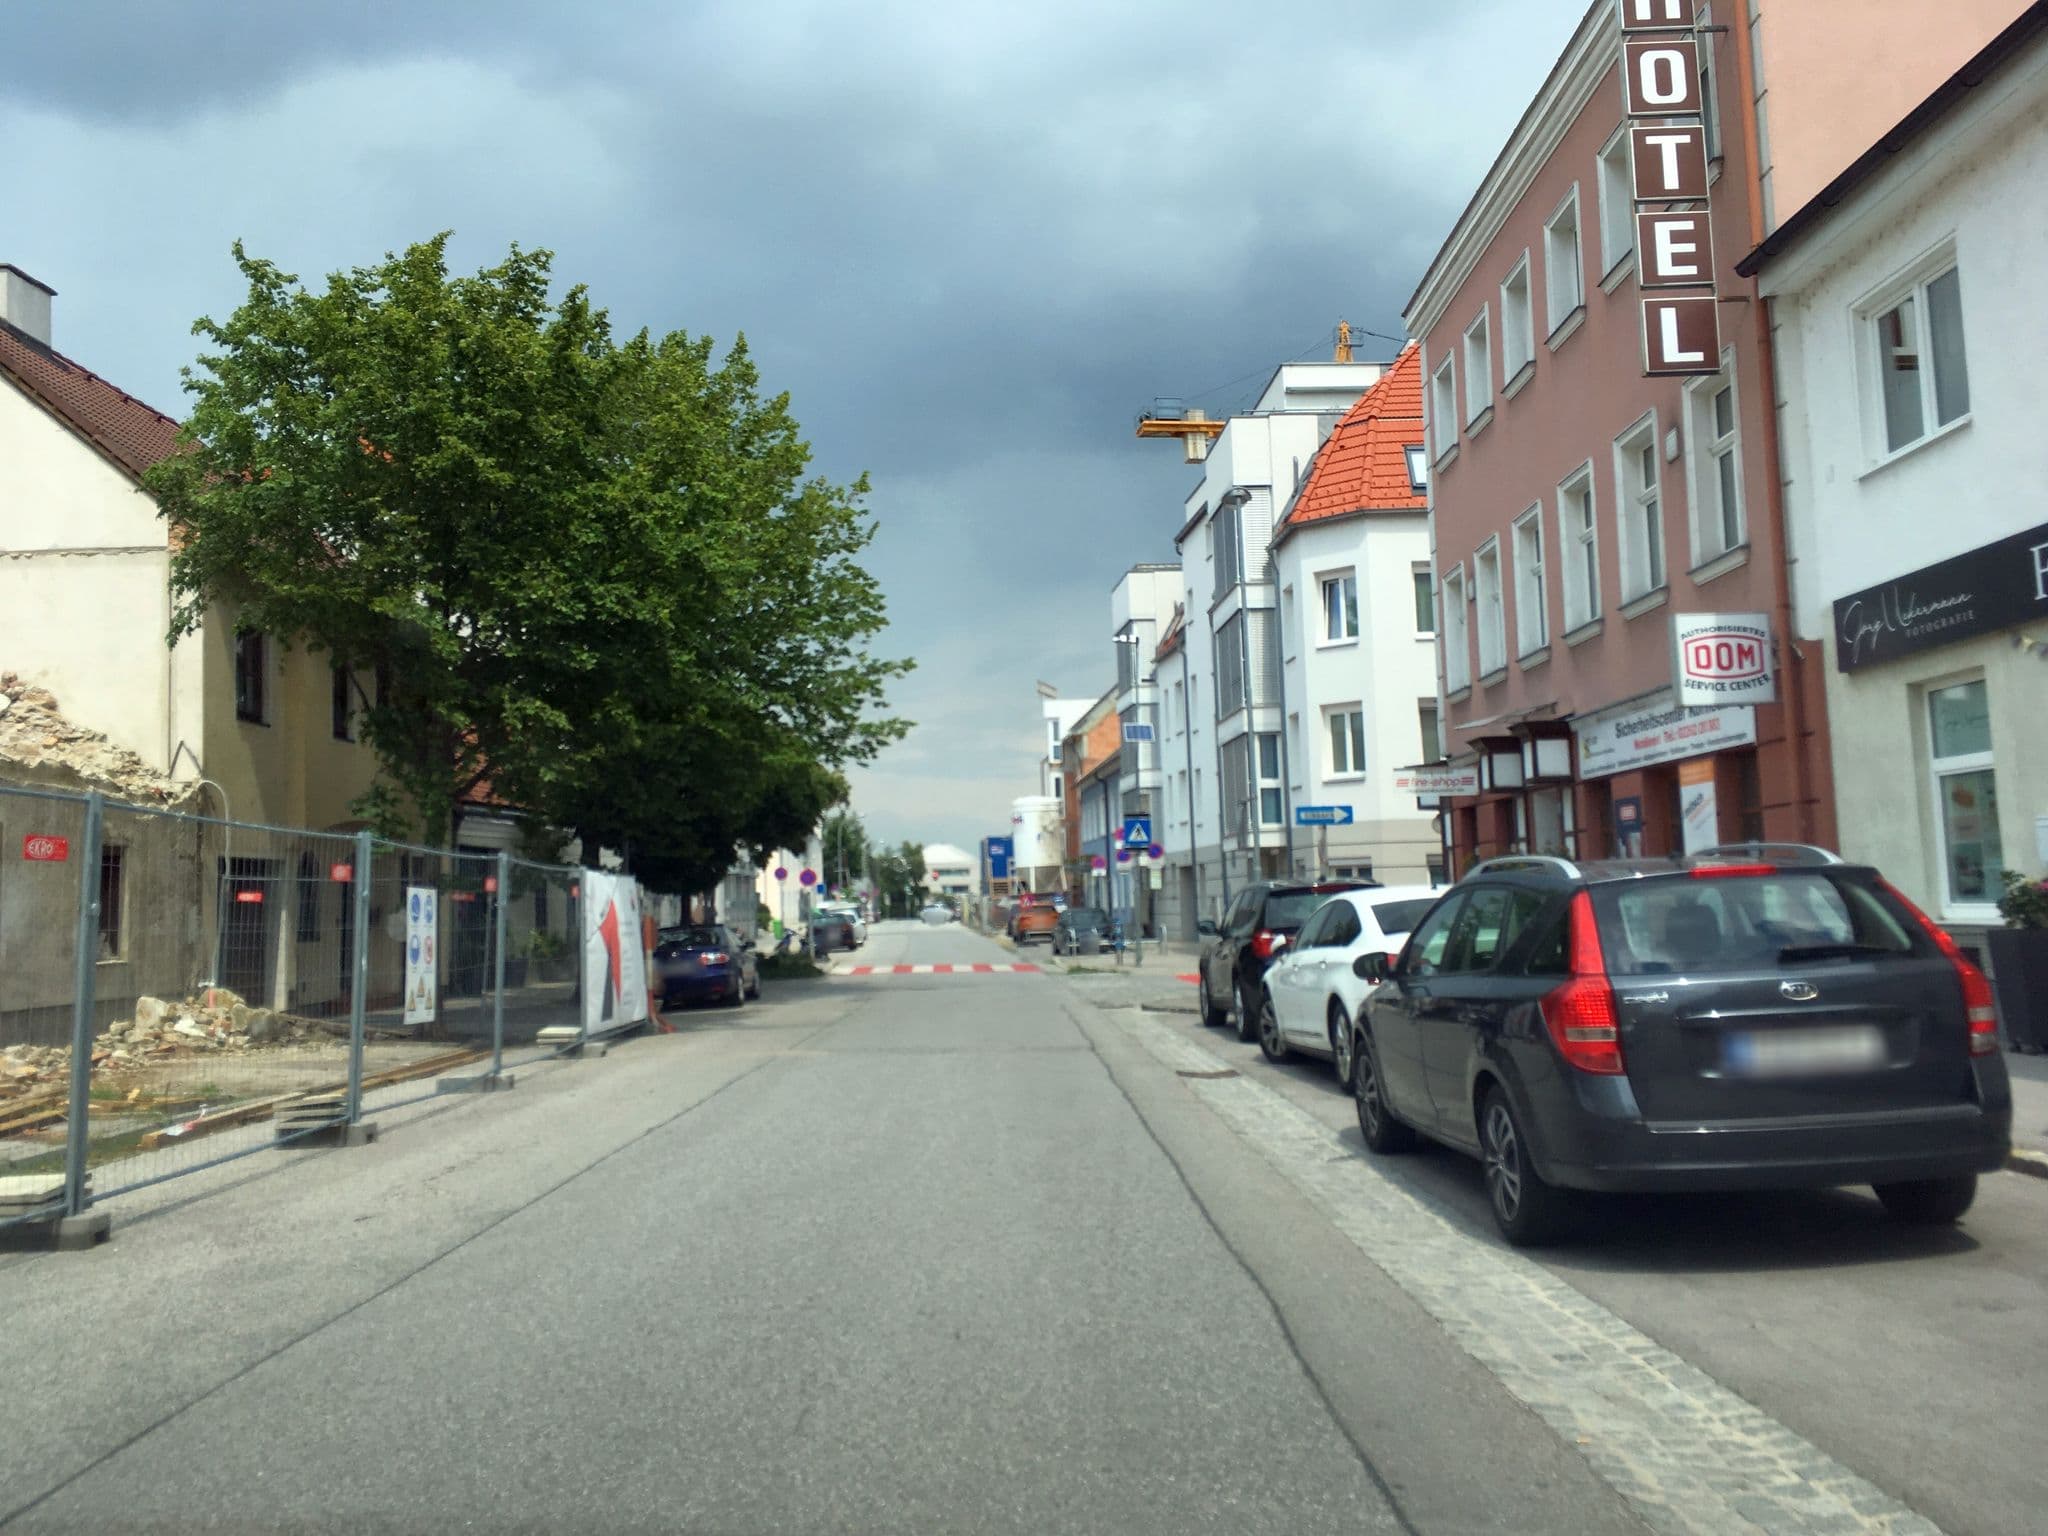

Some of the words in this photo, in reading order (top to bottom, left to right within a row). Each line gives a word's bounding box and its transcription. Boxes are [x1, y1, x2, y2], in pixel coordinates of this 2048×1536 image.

[1694, 642, 1756, 671] DOM
[1685, 679, 1728, 692] SERVICE
[1729, 673, 1771, 692] CENTER
